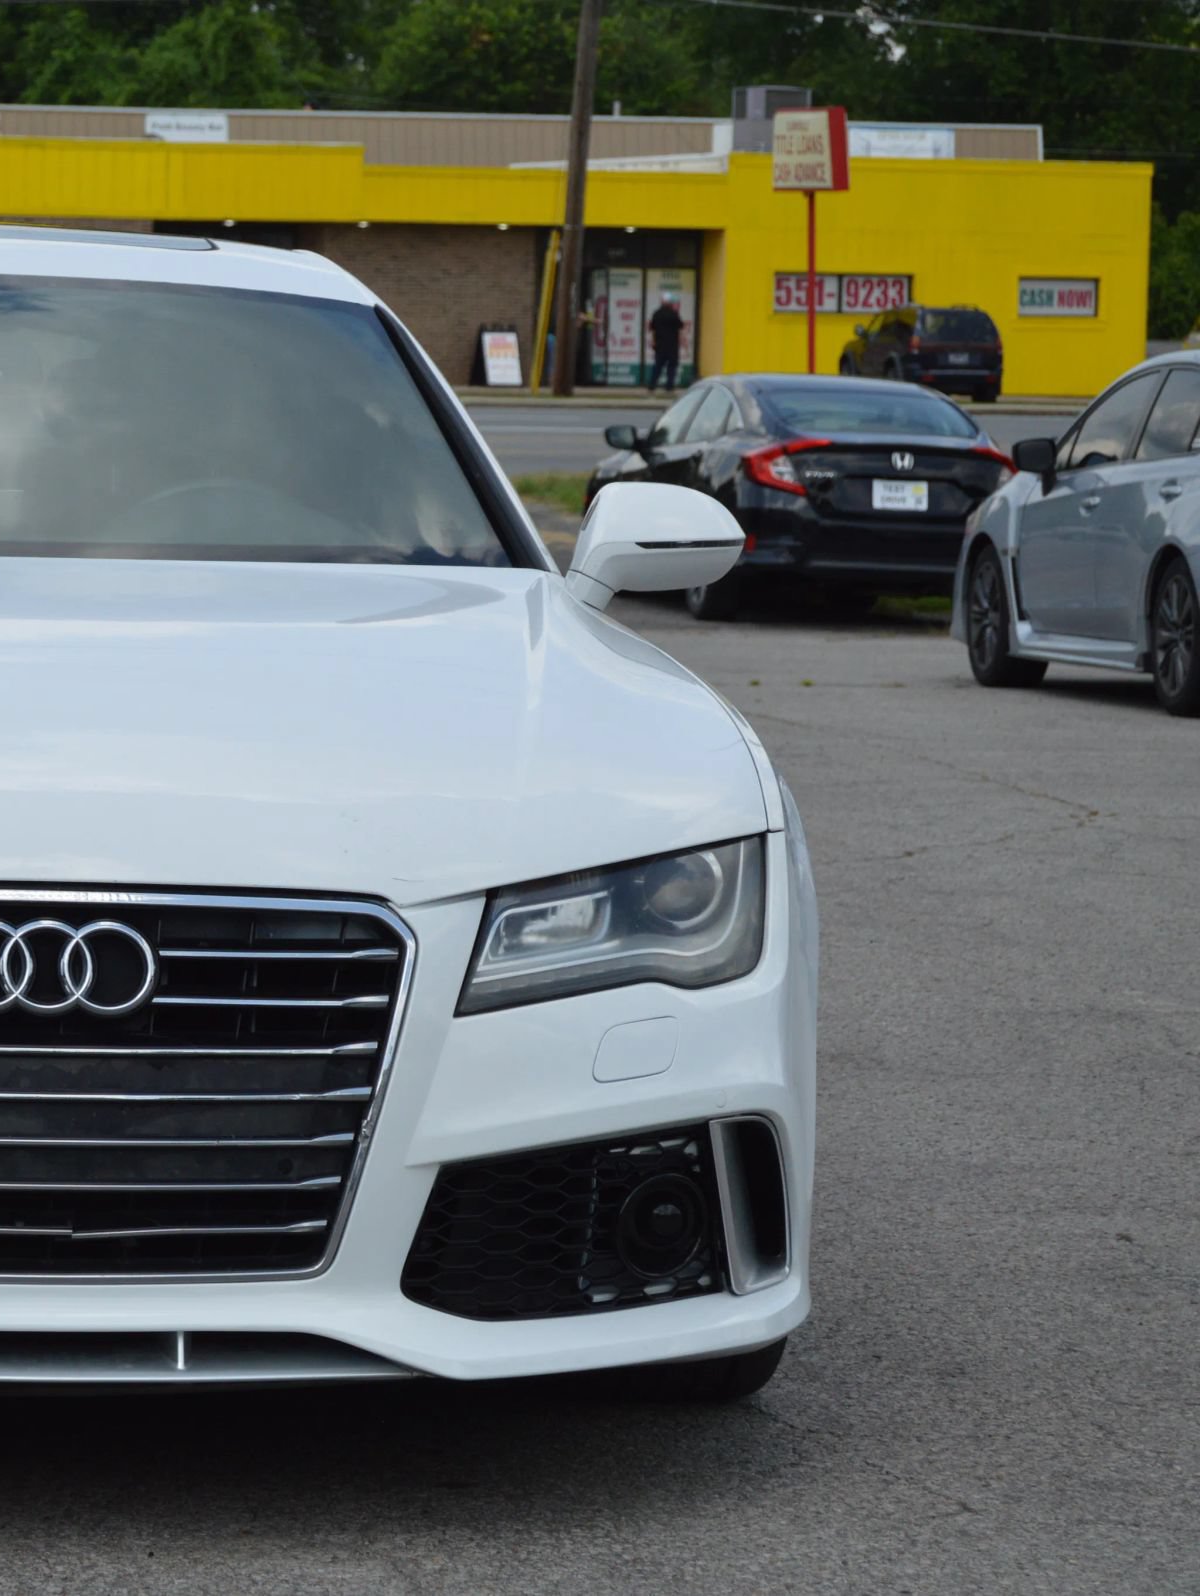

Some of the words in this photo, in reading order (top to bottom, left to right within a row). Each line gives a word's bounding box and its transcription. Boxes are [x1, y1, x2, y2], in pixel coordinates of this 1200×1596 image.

[796, 134, 824, 155] LOANS
[793, 161, 827, 183] ADVANCE
[846, 279, 905, 308] 9233
[1020, 287, 1055, 307] CASH
[1056, 288, 1094, 309] NOW!
